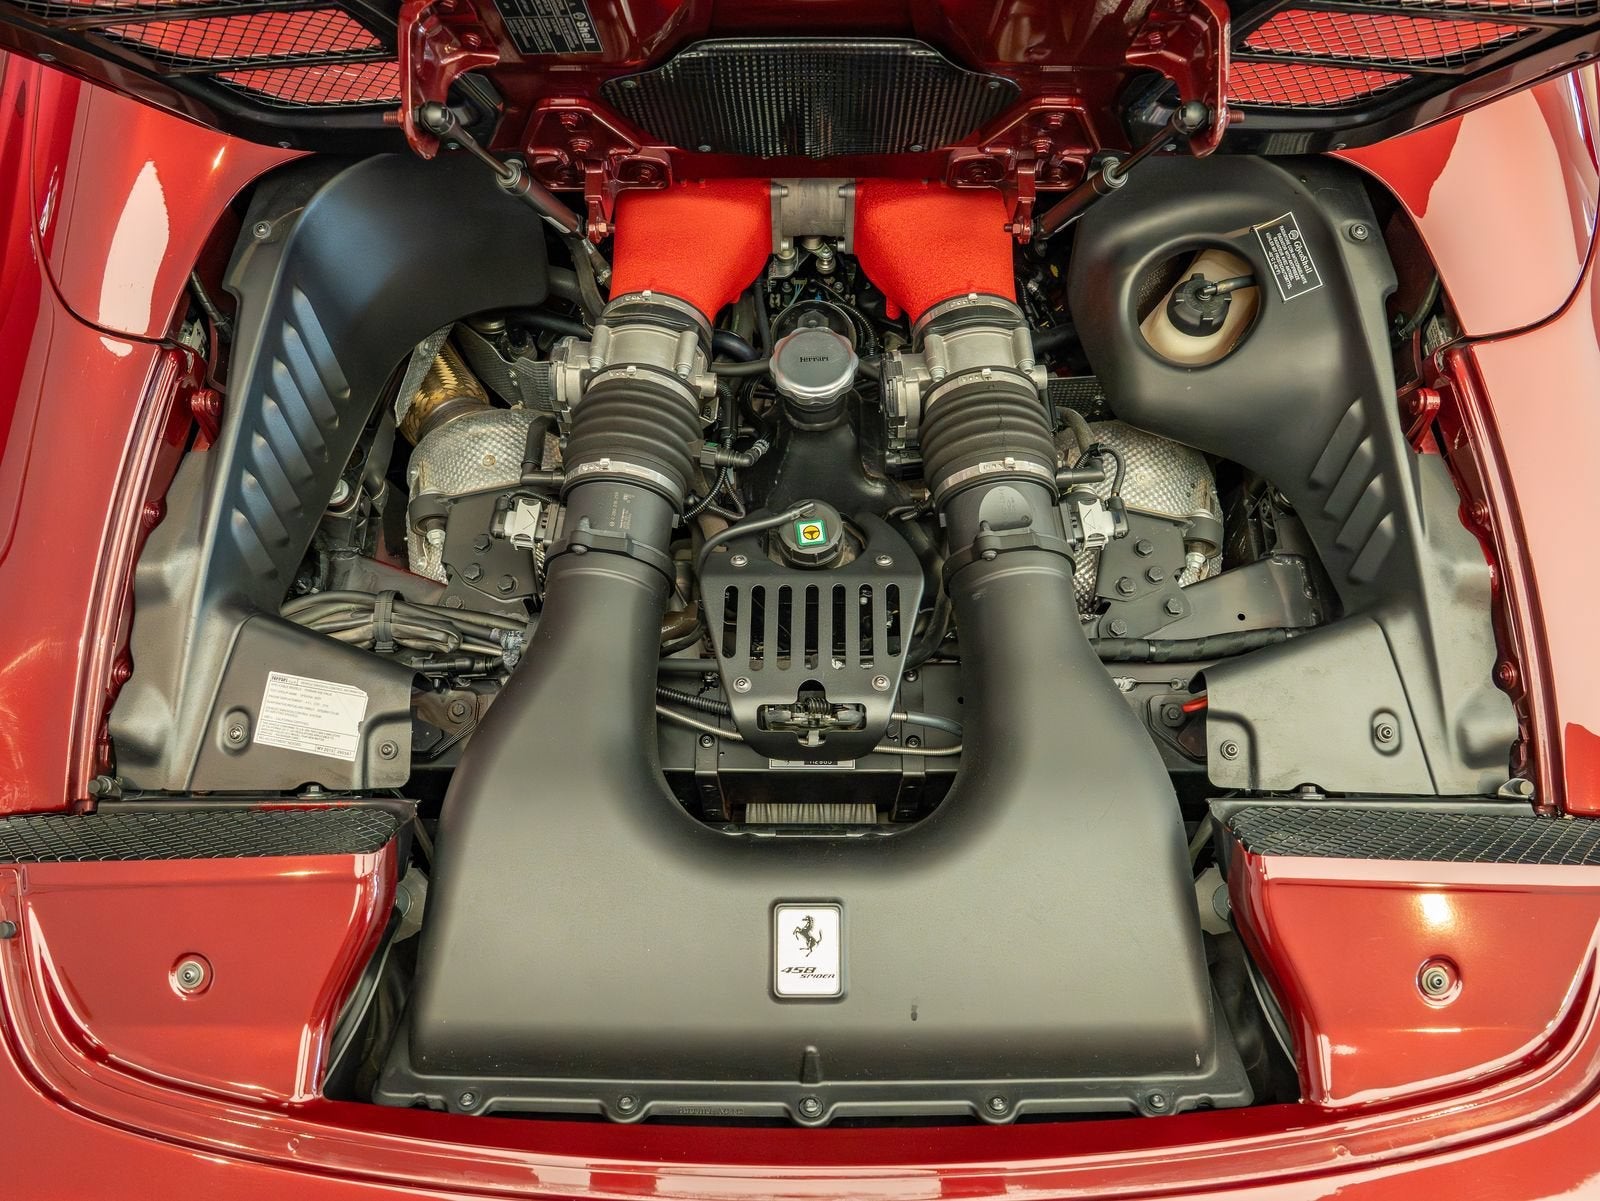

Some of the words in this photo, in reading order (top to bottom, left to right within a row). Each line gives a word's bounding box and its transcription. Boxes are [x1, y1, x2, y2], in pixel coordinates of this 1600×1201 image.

[576, 21, 595, 44] Shell
[1294, 241, 1313, 274] GlycoShell
[799, 355, 829, 363] Ferrari
[271, 675, 288, 683] Ferrari
